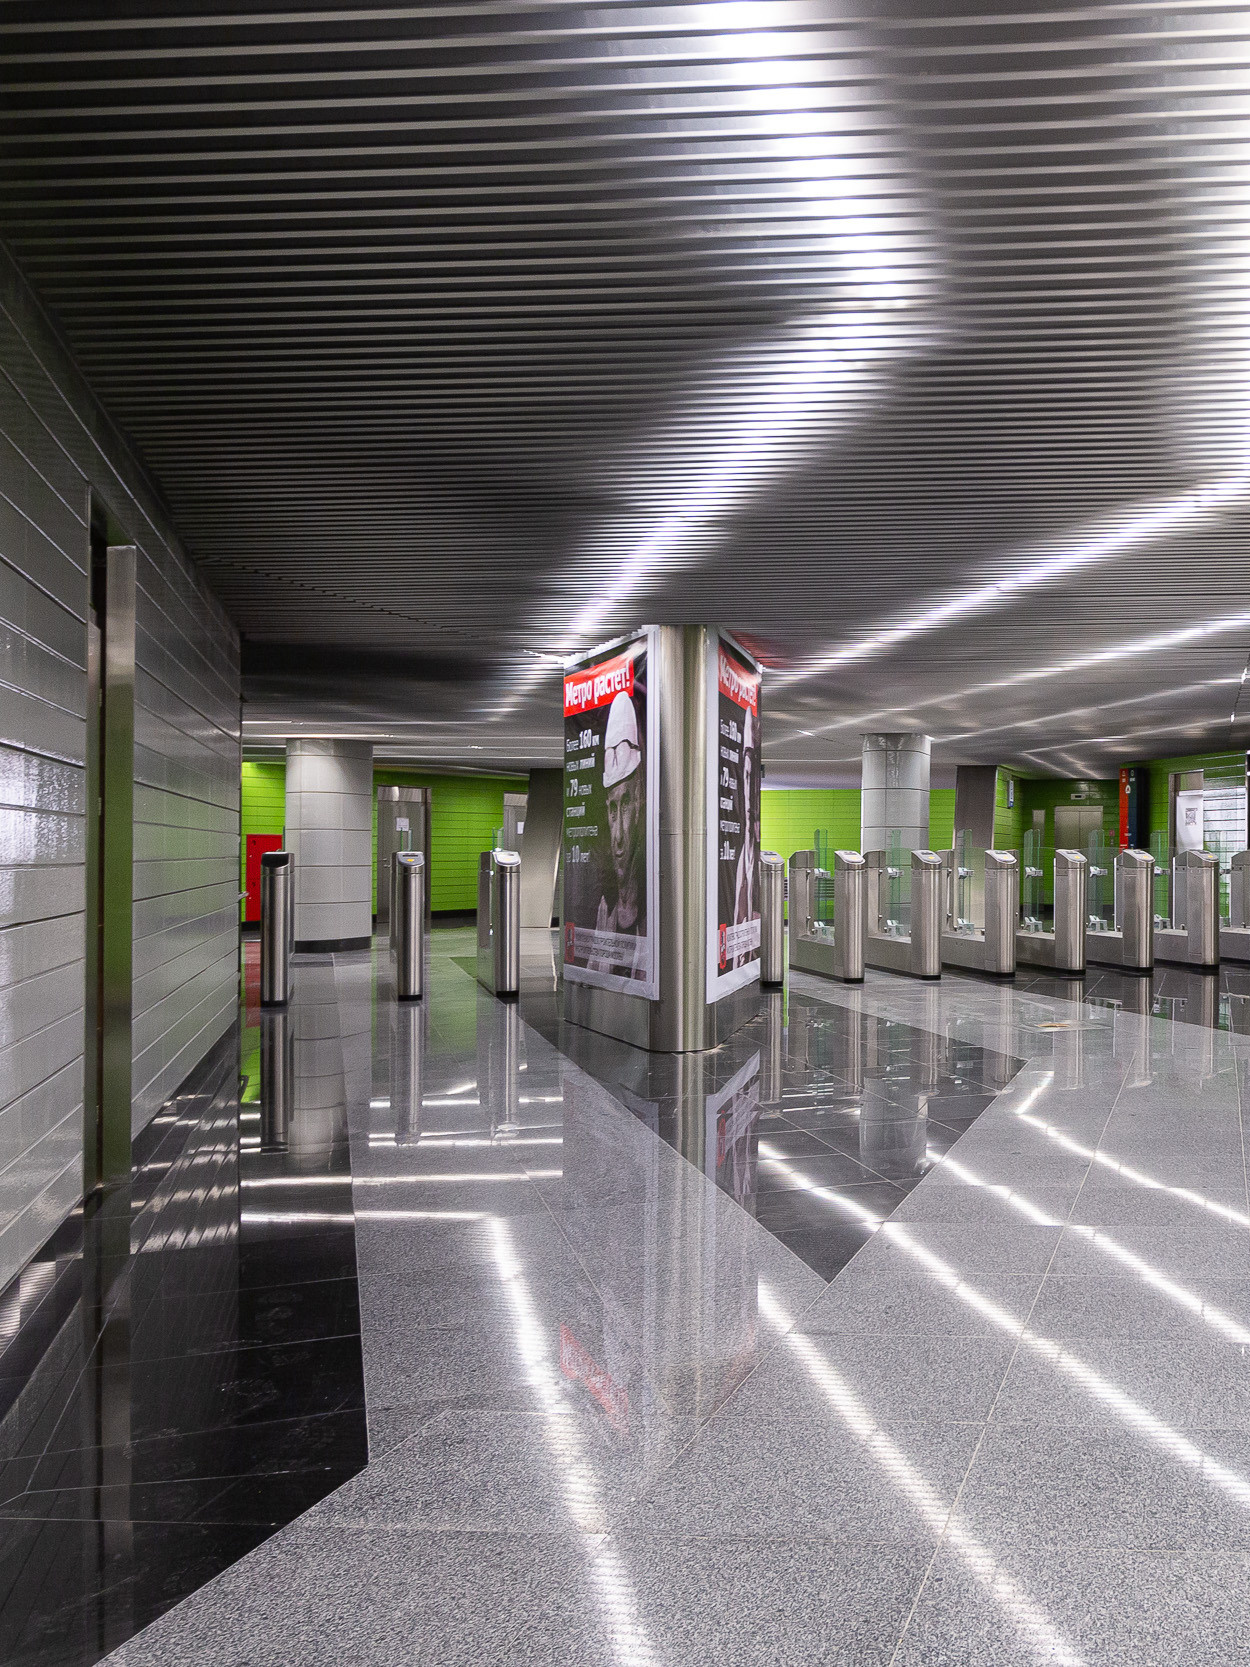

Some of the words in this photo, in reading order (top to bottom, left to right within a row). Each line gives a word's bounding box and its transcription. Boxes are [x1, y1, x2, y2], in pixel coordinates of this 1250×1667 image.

[565, 680, 593, 709] Метро
[593, 659, 631, 705] растет!
[579, 729, 592, 750] 160
[569, 778, 579, 797] 79
[571, 845, 580, 863] 10
